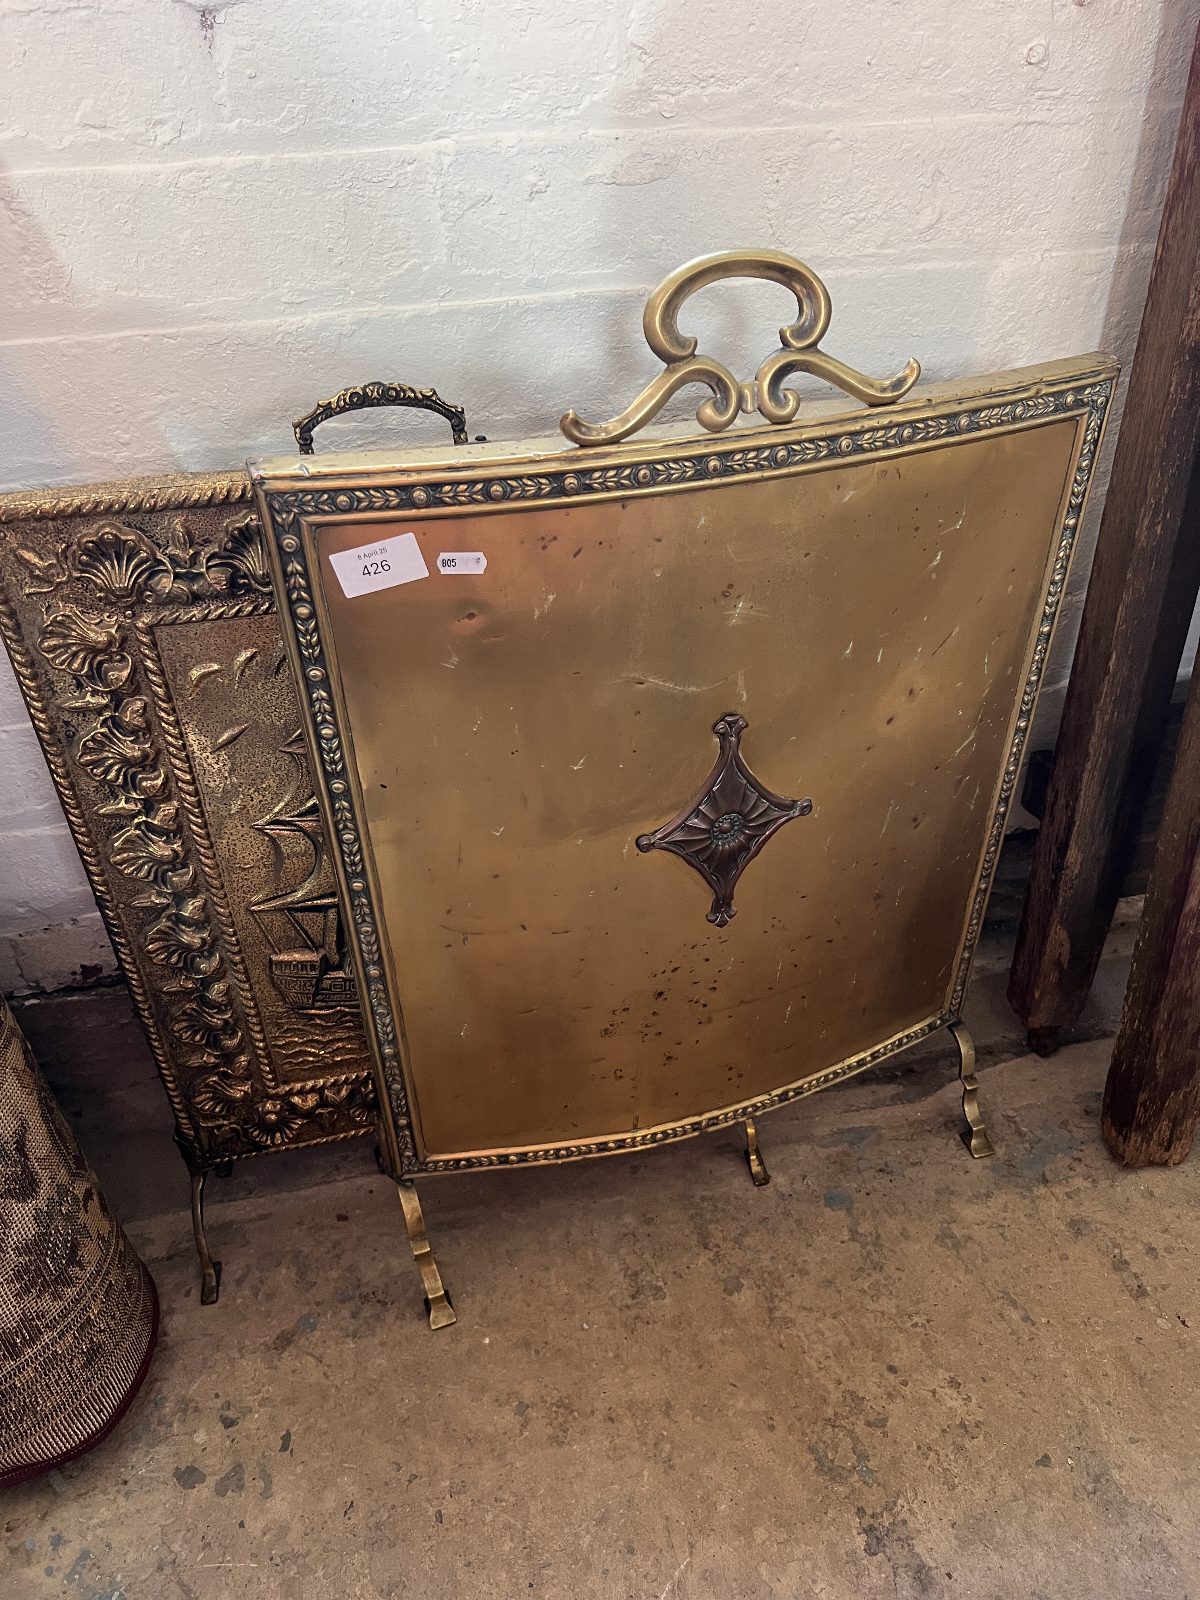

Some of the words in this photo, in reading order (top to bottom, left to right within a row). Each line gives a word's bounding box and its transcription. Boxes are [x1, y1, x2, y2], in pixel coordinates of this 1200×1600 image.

[363, 549, 379, 559] April
[379, 547, 388, 555] 25
[362, 559, 391, 577] 426
[441, 558, 457, 568] 805
